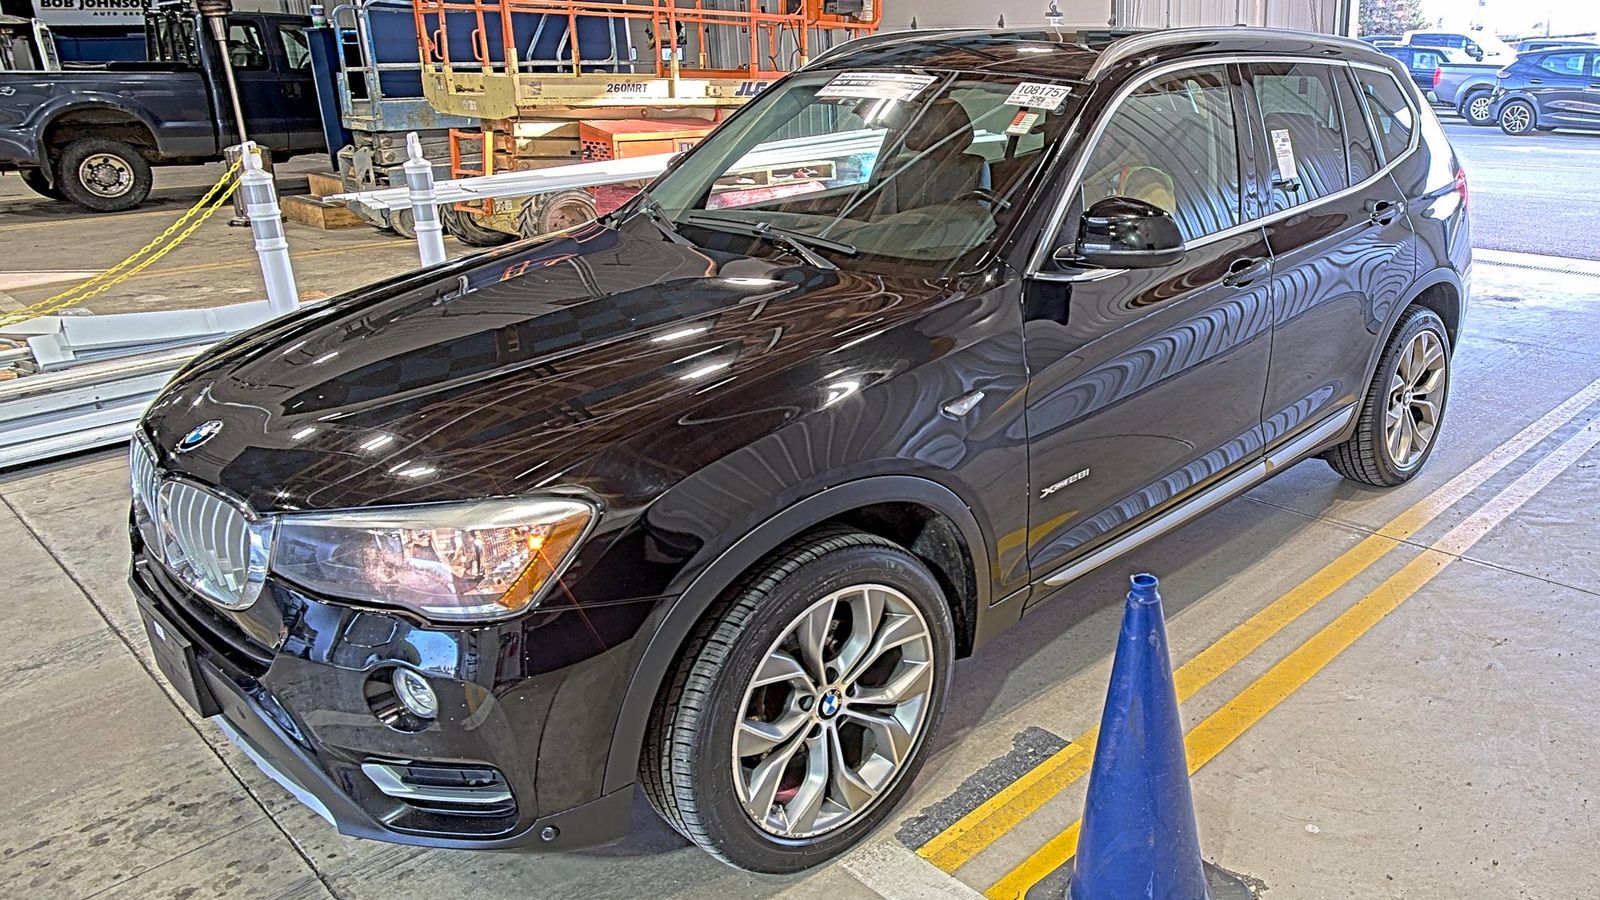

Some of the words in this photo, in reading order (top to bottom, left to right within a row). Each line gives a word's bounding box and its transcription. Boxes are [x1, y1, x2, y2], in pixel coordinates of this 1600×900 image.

[41, 0, 75, 8] BOB
[79, 0, 152, 10] JOHNSON
[606, 83, 648, 93] 260MRT
[735, 81, 768, 96] JLG
[1019, 84, 1069, 98] 1081757
